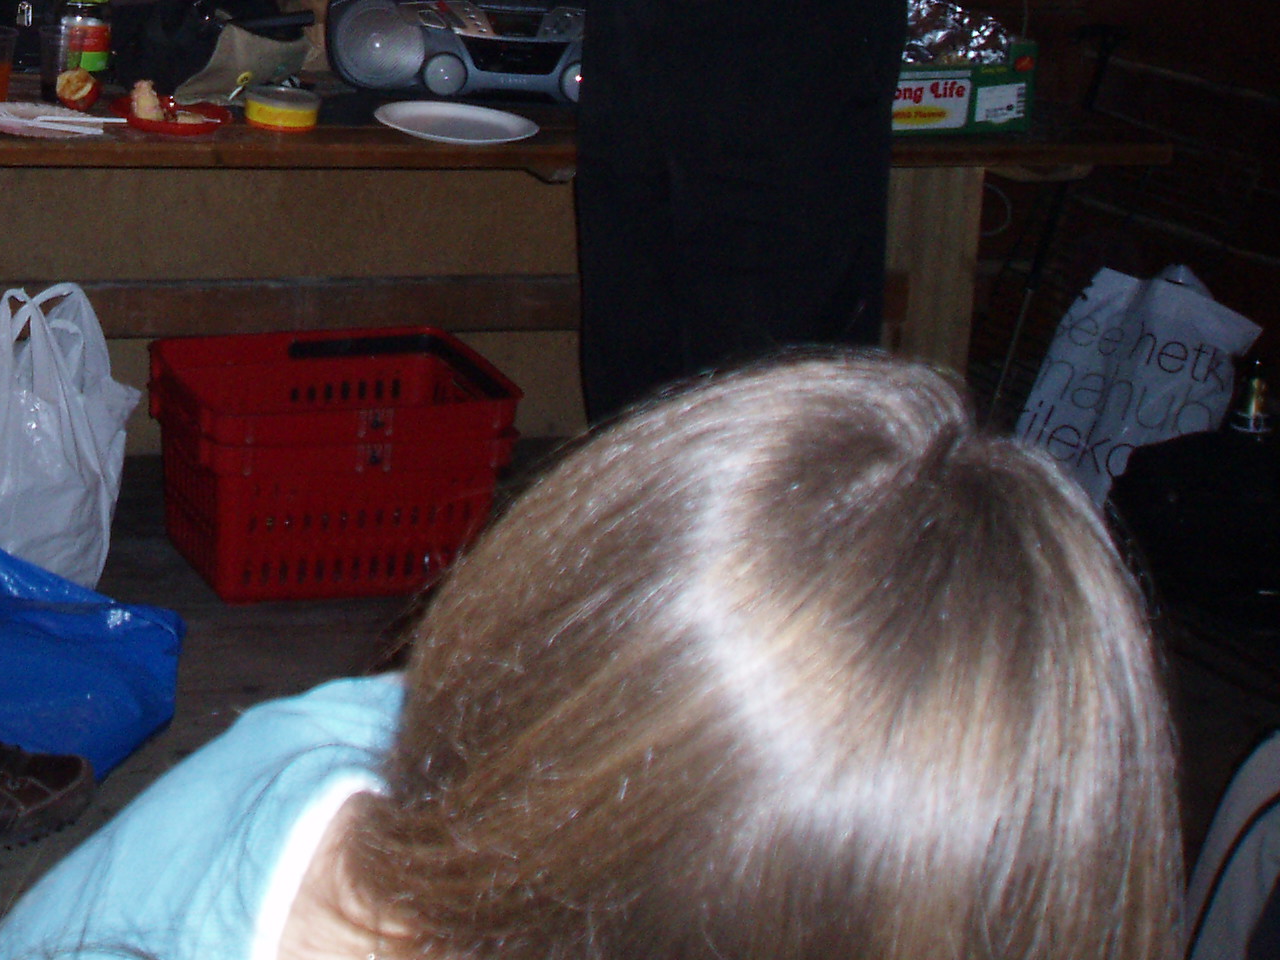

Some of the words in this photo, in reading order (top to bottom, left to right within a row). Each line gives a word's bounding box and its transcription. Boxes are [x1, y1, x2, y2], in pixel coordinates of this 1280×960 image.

[893, 85, 925, 104] ong
[929, 80, 966, 99] Life
[1021, 398, 1136, 478] ileko
